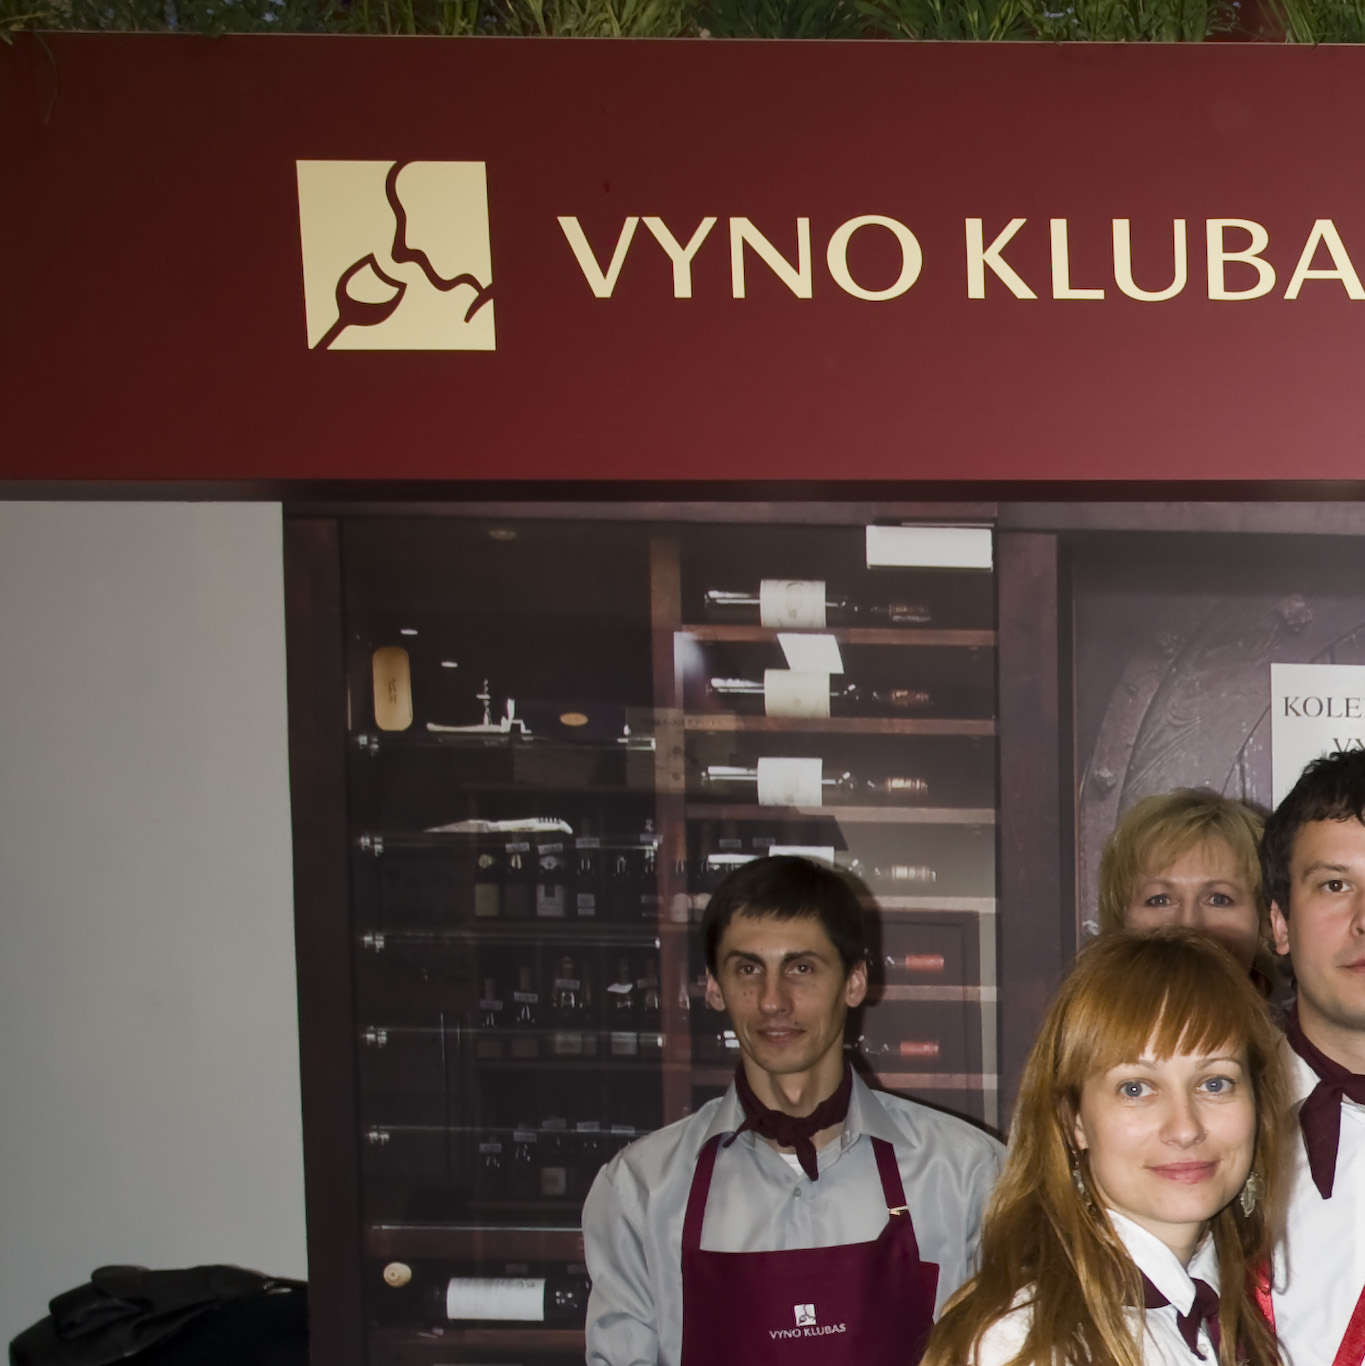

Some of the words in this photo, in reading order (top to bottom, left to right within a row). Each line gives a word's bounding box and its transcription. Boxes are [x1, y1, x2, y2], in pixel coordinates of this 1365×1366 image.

[557, 215, 923, 302] VYNO
[769, 1328, 802, 1340] VYNO
[804, 1323, 847, 1337] KLUBAS
